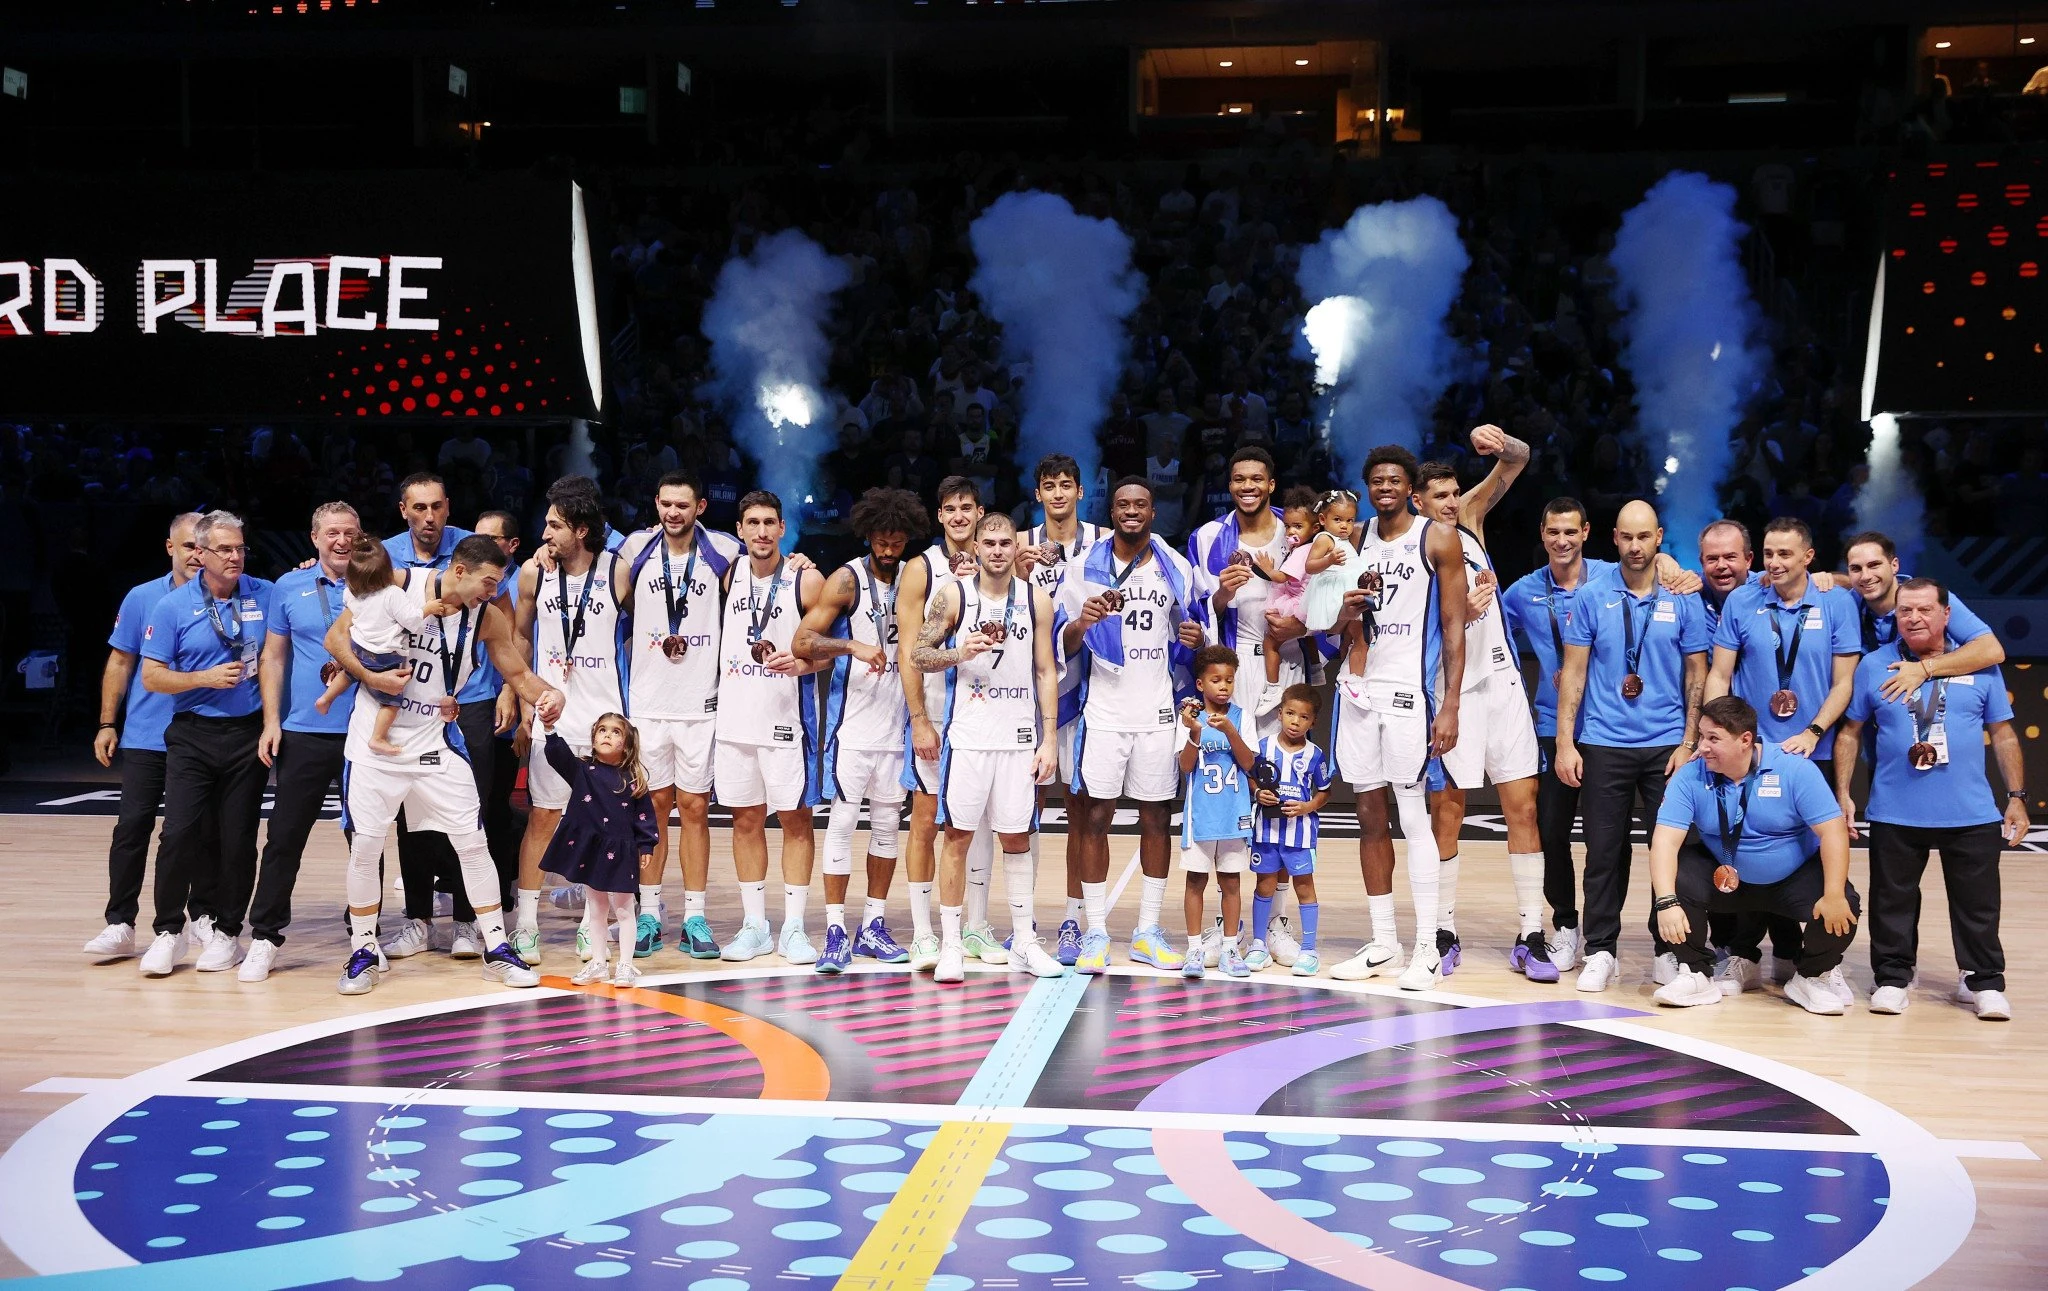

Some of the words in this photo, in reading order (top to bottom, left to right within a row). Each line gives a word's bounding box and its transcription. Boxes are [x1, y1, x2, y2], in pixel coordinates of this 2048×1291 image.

[142, 255, 443, 337] PLACE
[708, 488, 737, 501] FINLAND
[1207, 493, 1232, 503] FINLAN
[1368, 561, 1416, 581] LLAS
[732, 596, 783, 619] HELLS
[1119, 586, 1168, 608] ELLAS
[1125, 609, 1153, 631] 43
[992, 649, 1005, 670] 7
[409, 658, 434, 684] 10
[1203, 763, 1239, 795] 34
